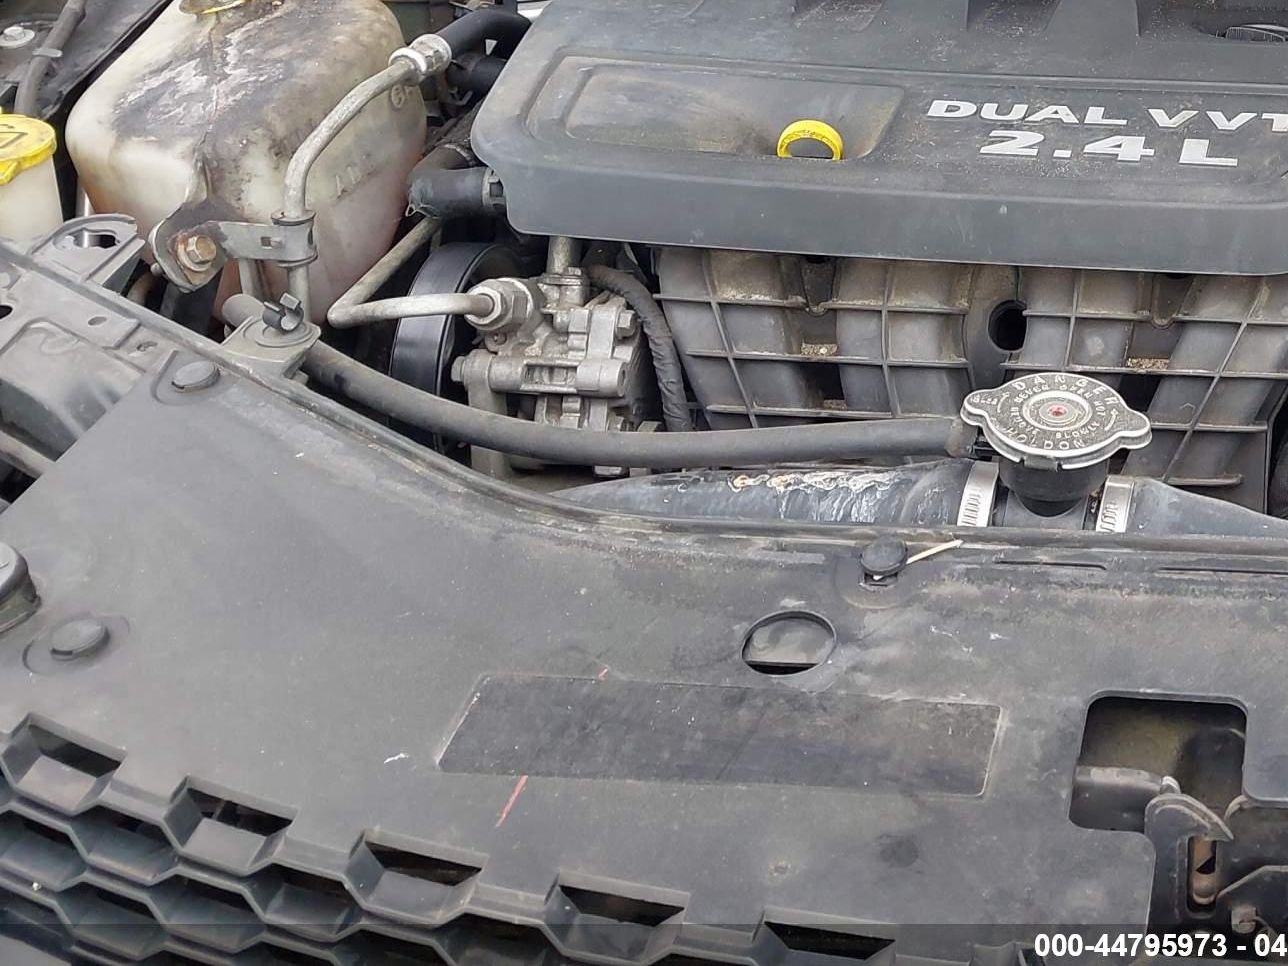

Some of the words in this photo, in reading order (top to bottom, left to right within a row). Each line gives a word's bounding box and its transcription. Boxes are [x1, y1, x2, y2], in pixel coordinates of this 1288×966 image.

[926, 99, 1128, 126] DUAL
[1012, 375, 1120, 404] DANGER
[1014, 384, 1050, 403] NEVER
[1059, 384, 1094, 398] OPEN
[1093, 400, 1106, 416] HOT
[1010, 406, 1041, 435] REMOVE
[1055, 421, 1101, 439] SLOWLY
